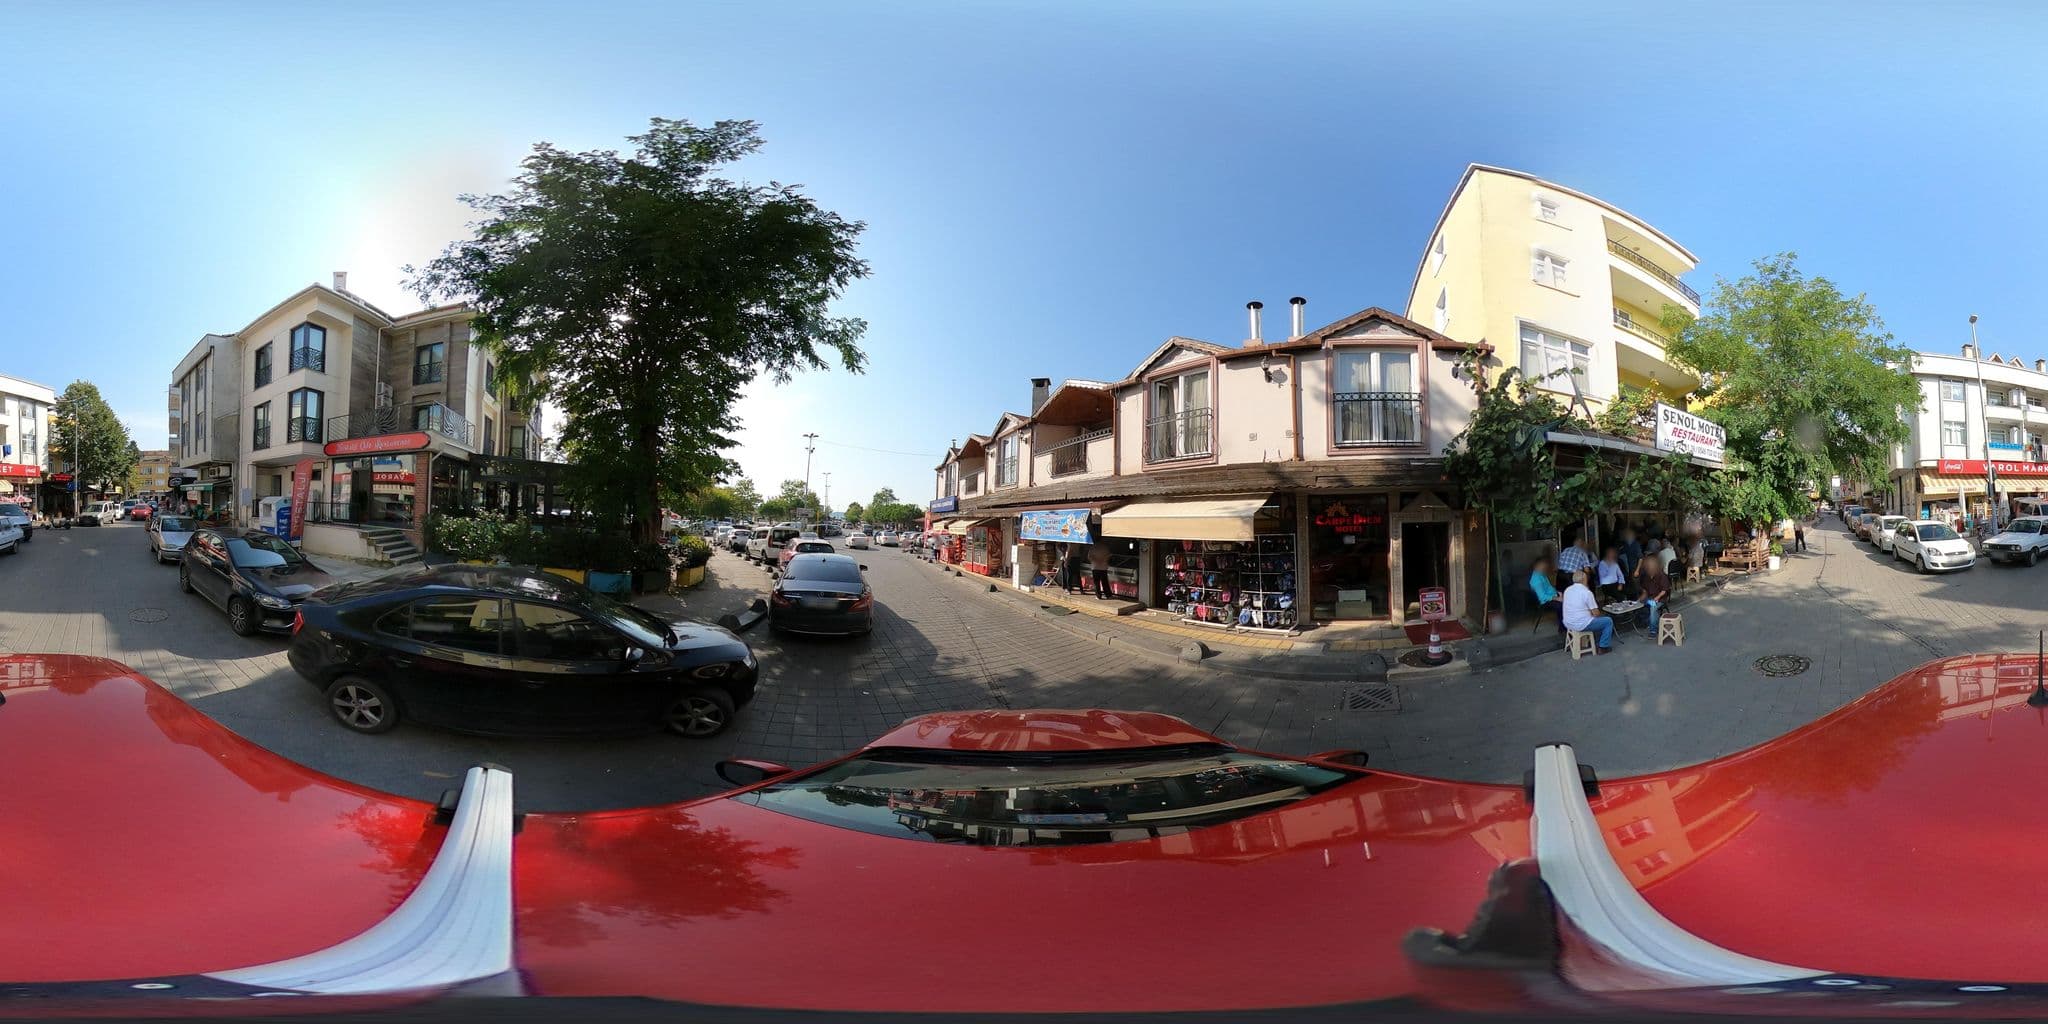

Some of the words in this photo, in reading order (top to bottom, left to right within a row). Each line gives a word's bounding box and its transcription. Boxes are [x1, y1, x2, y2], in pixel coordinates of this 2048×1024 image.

[1663, 409, 1696, 430] ŞENOL
[1698, 421, 1723, 440] MOTEL
[1671, 426, 1718, 446] RESTAURANT
[1315, 514, 1352, 525] CARPE
